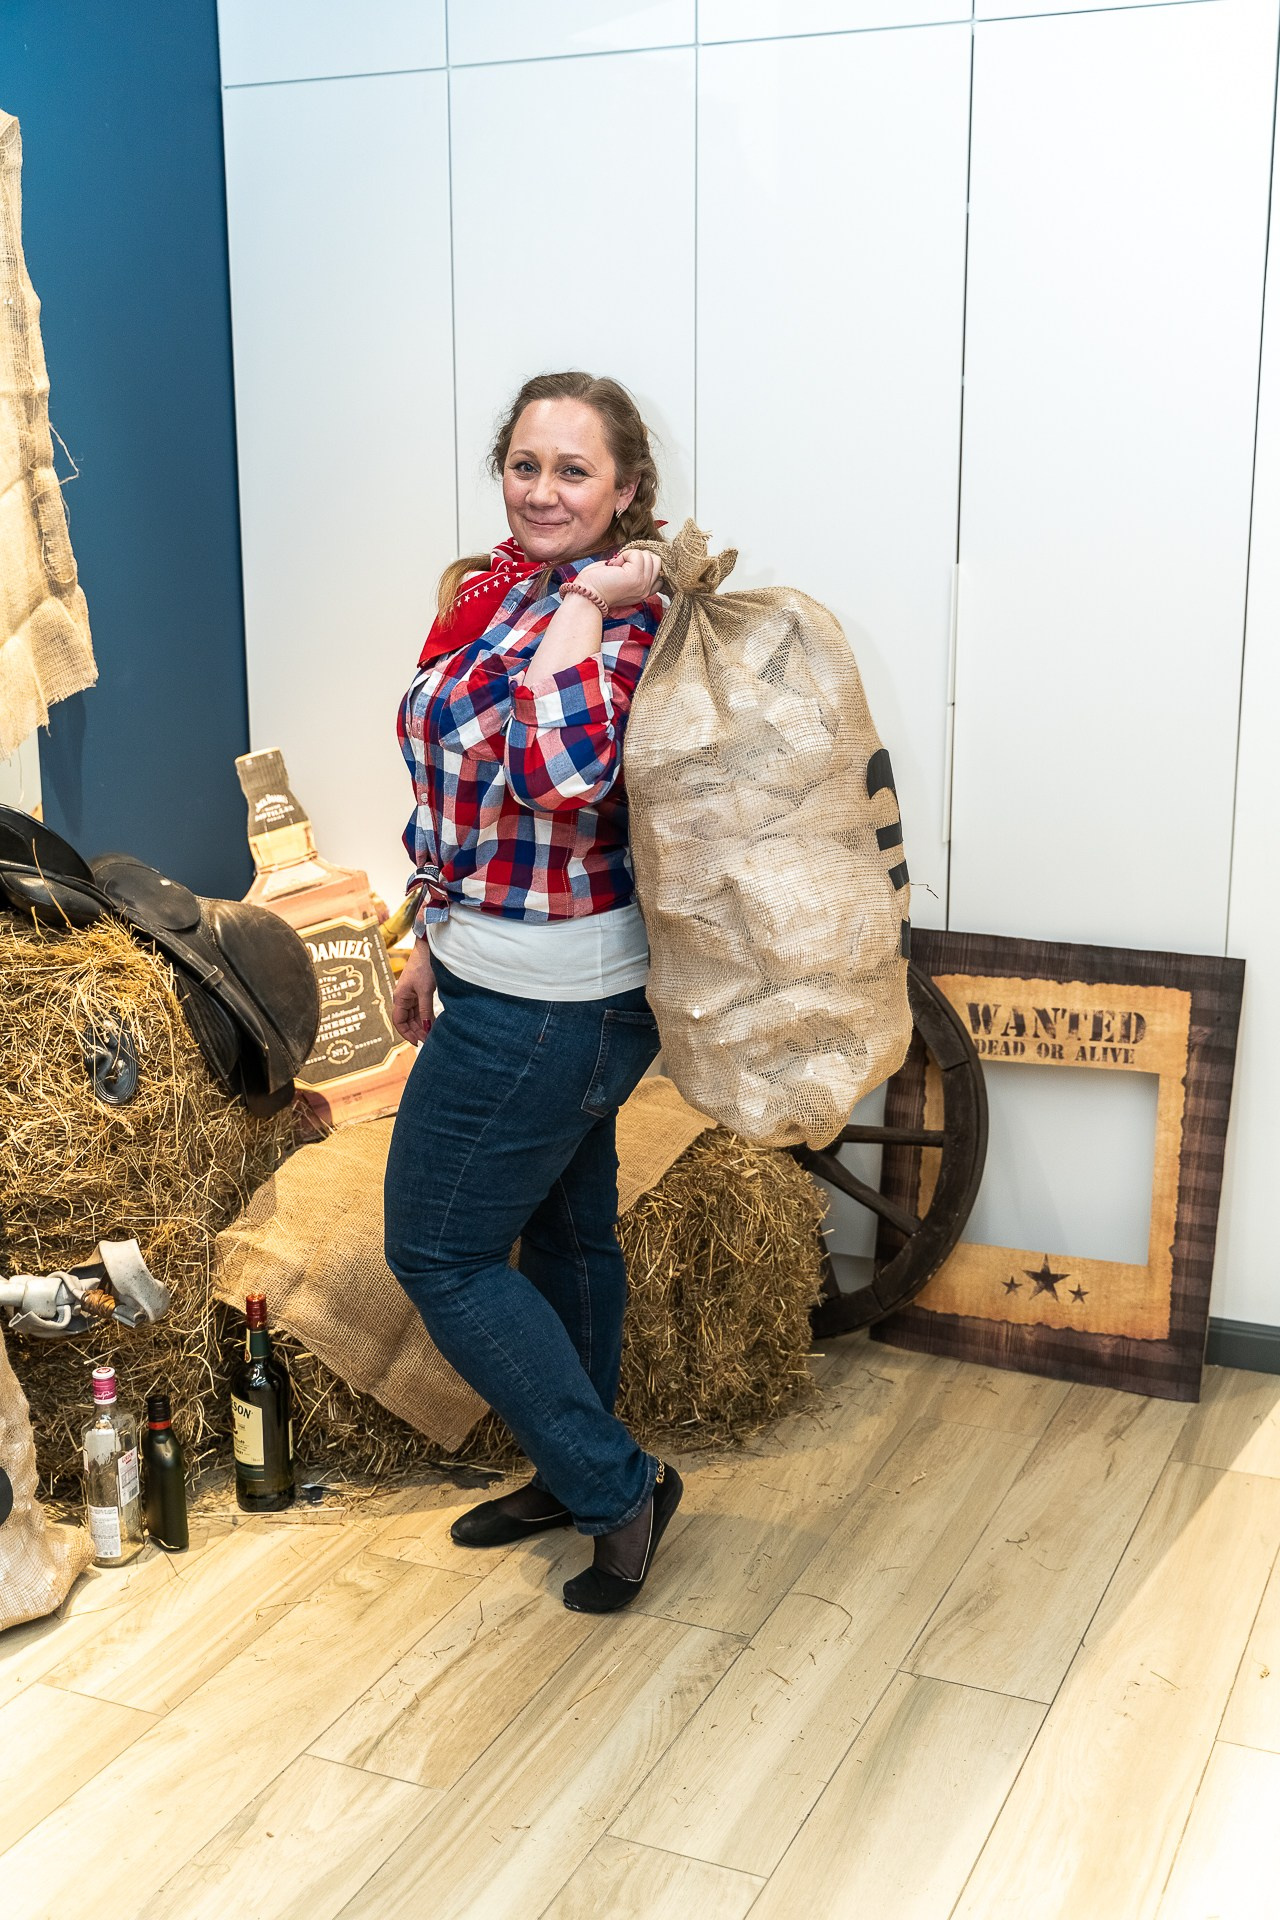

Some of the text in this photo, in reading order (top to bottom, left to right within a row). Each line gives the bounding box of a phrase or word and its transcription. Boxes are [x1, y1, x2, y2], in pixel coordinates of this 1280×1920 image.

[305, 936, 373, 963] DANIEL'S
[319, 976, 338, 984] STER
[321, 979, 357, 995] ILLER
[322, 991, 342, 1001] RIES
[319, 1012, 367, 1033] NNESSEE
[966, 1002, 1147, 1045] WANTED
[305, 1055, 327, 1065] MITED
[974, 1038, 1135, 1064] DEAD OR ALIVE
[232, 1401, 251, 1419] SON
